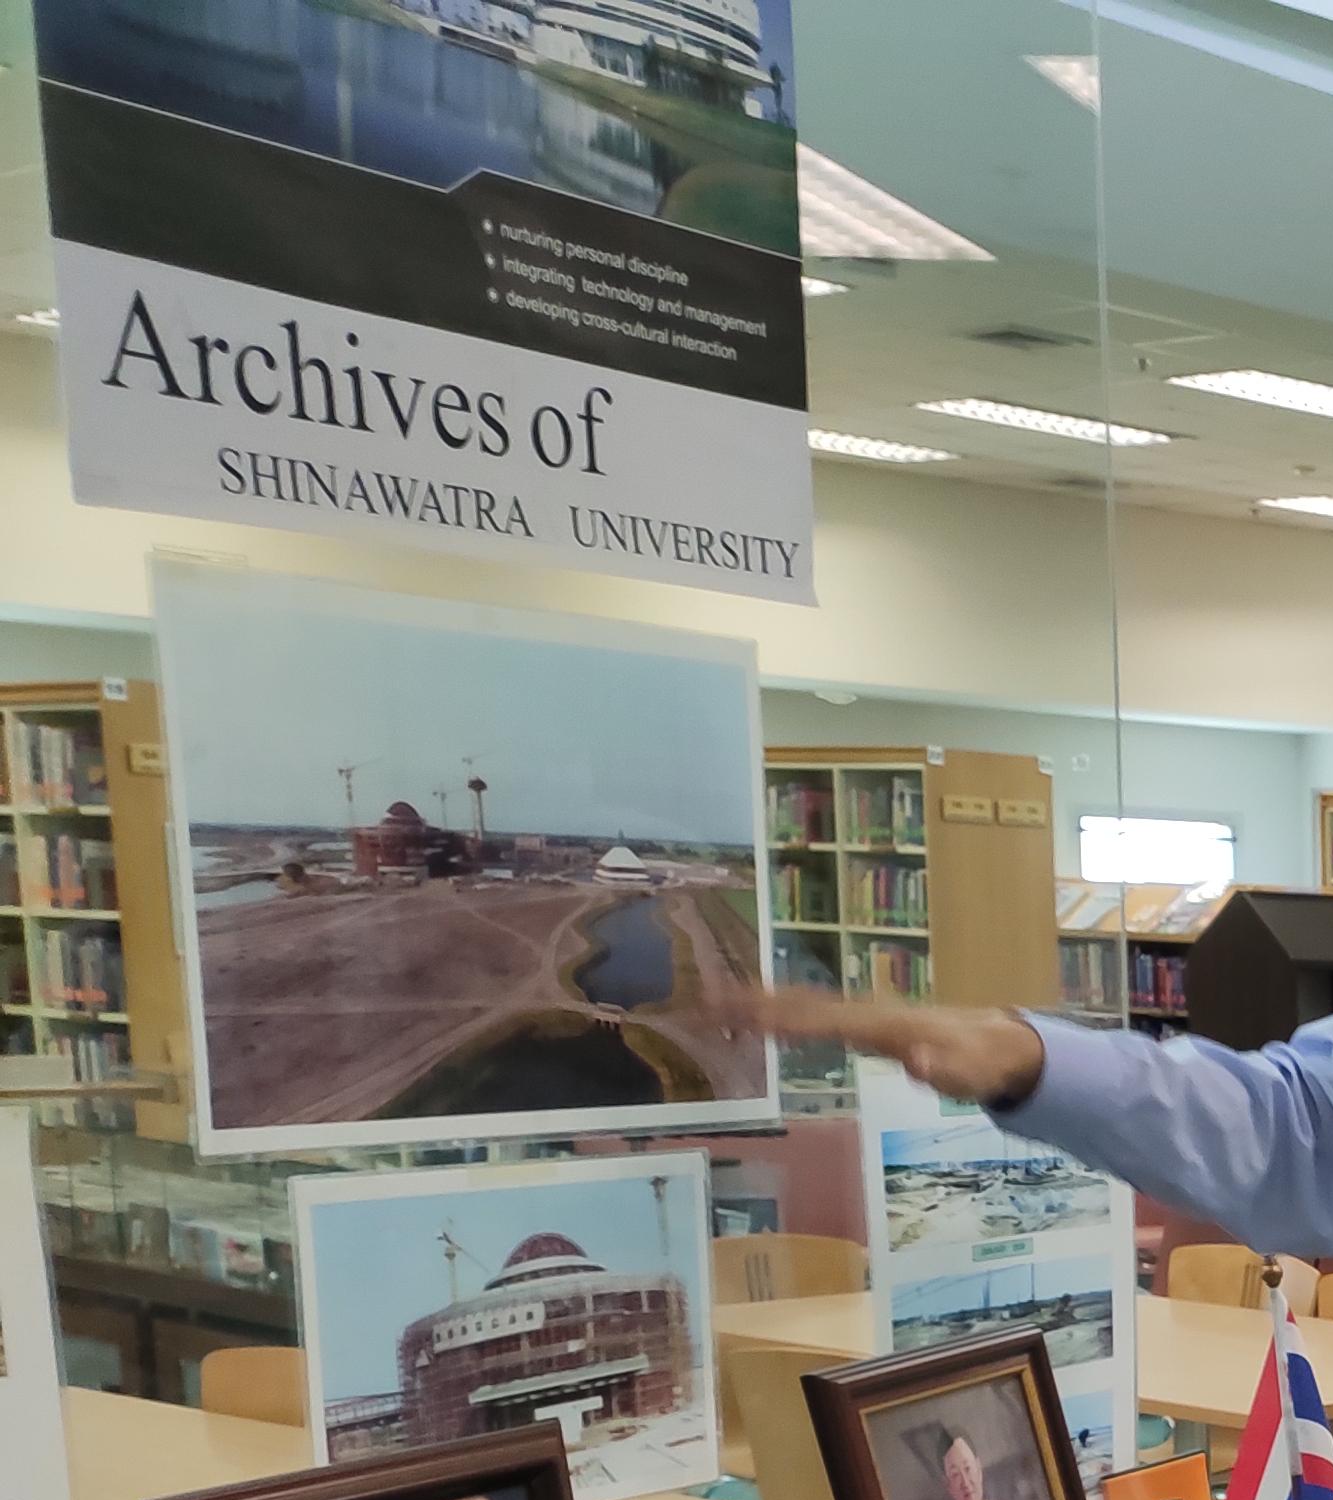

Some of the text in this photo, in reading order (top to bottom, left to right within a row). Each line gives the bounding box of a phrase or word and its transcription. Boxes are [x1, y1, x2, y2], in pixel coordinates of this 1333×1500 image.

[501, 222, 689, 287] nurturing personal discipline
[503, 255, 767, 338] integrating technology and management
[505, 290, 737, 360] developing cross-cultural interaction
[101, 289, 613, 476] Archives of
[217, 447, 800, 578] SHINAWATRA UNIVERSITY
